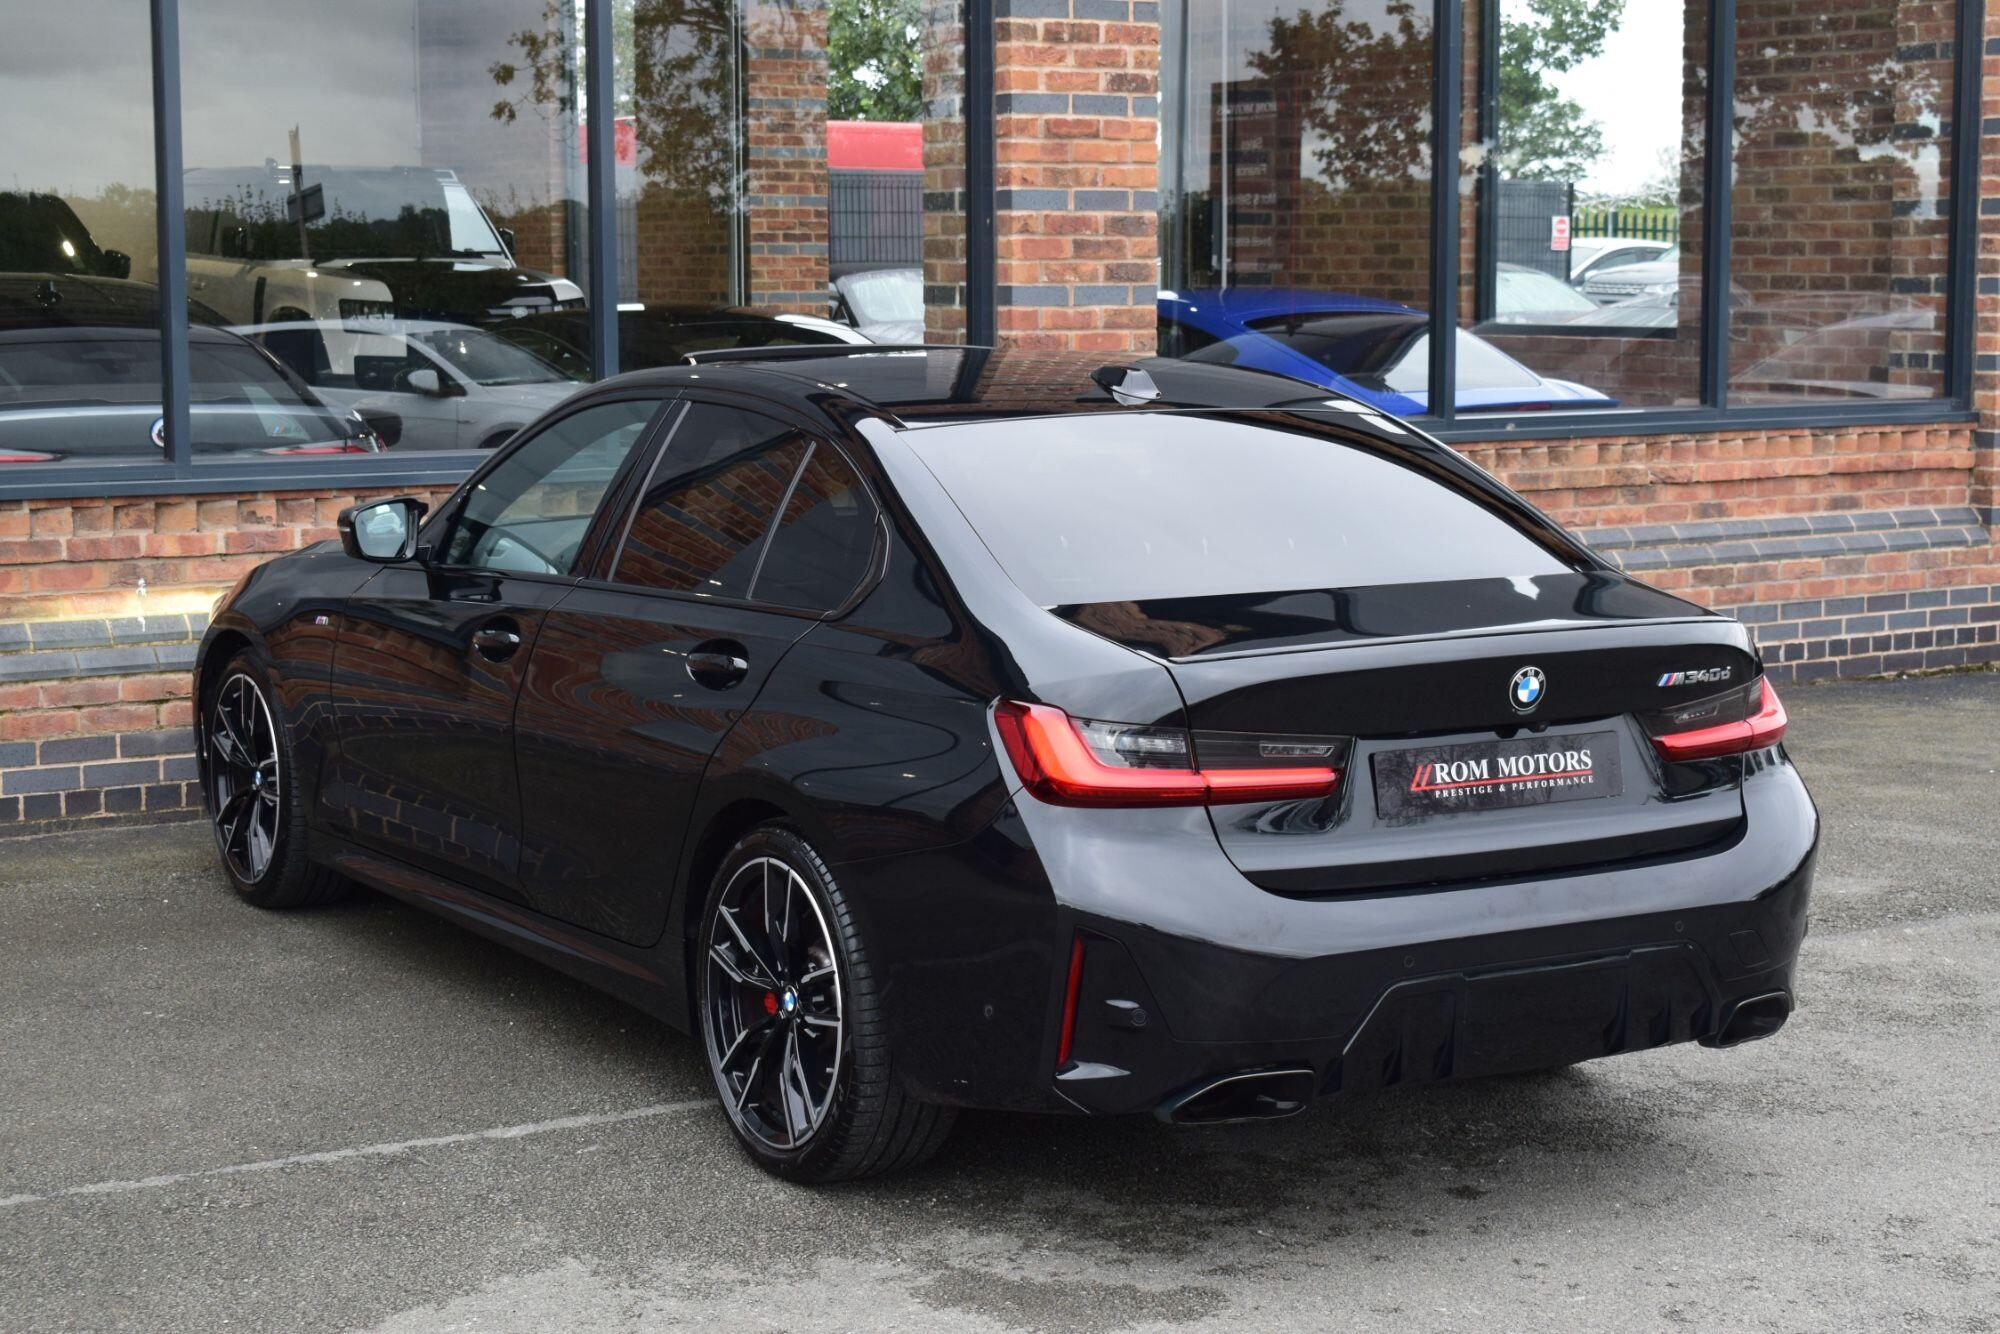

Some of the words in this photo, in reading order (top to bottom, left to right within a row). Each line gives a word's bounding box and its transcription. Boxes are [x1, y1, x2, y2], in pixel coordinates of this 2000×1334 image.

[1434, 760, 1490, 784] ROM
[1497, 749, 1593, 778] MOTORS
[1435, 785, 1493, 799] PRESTIGE
[1512, 775, 1594, 791] PERFORMANCE
